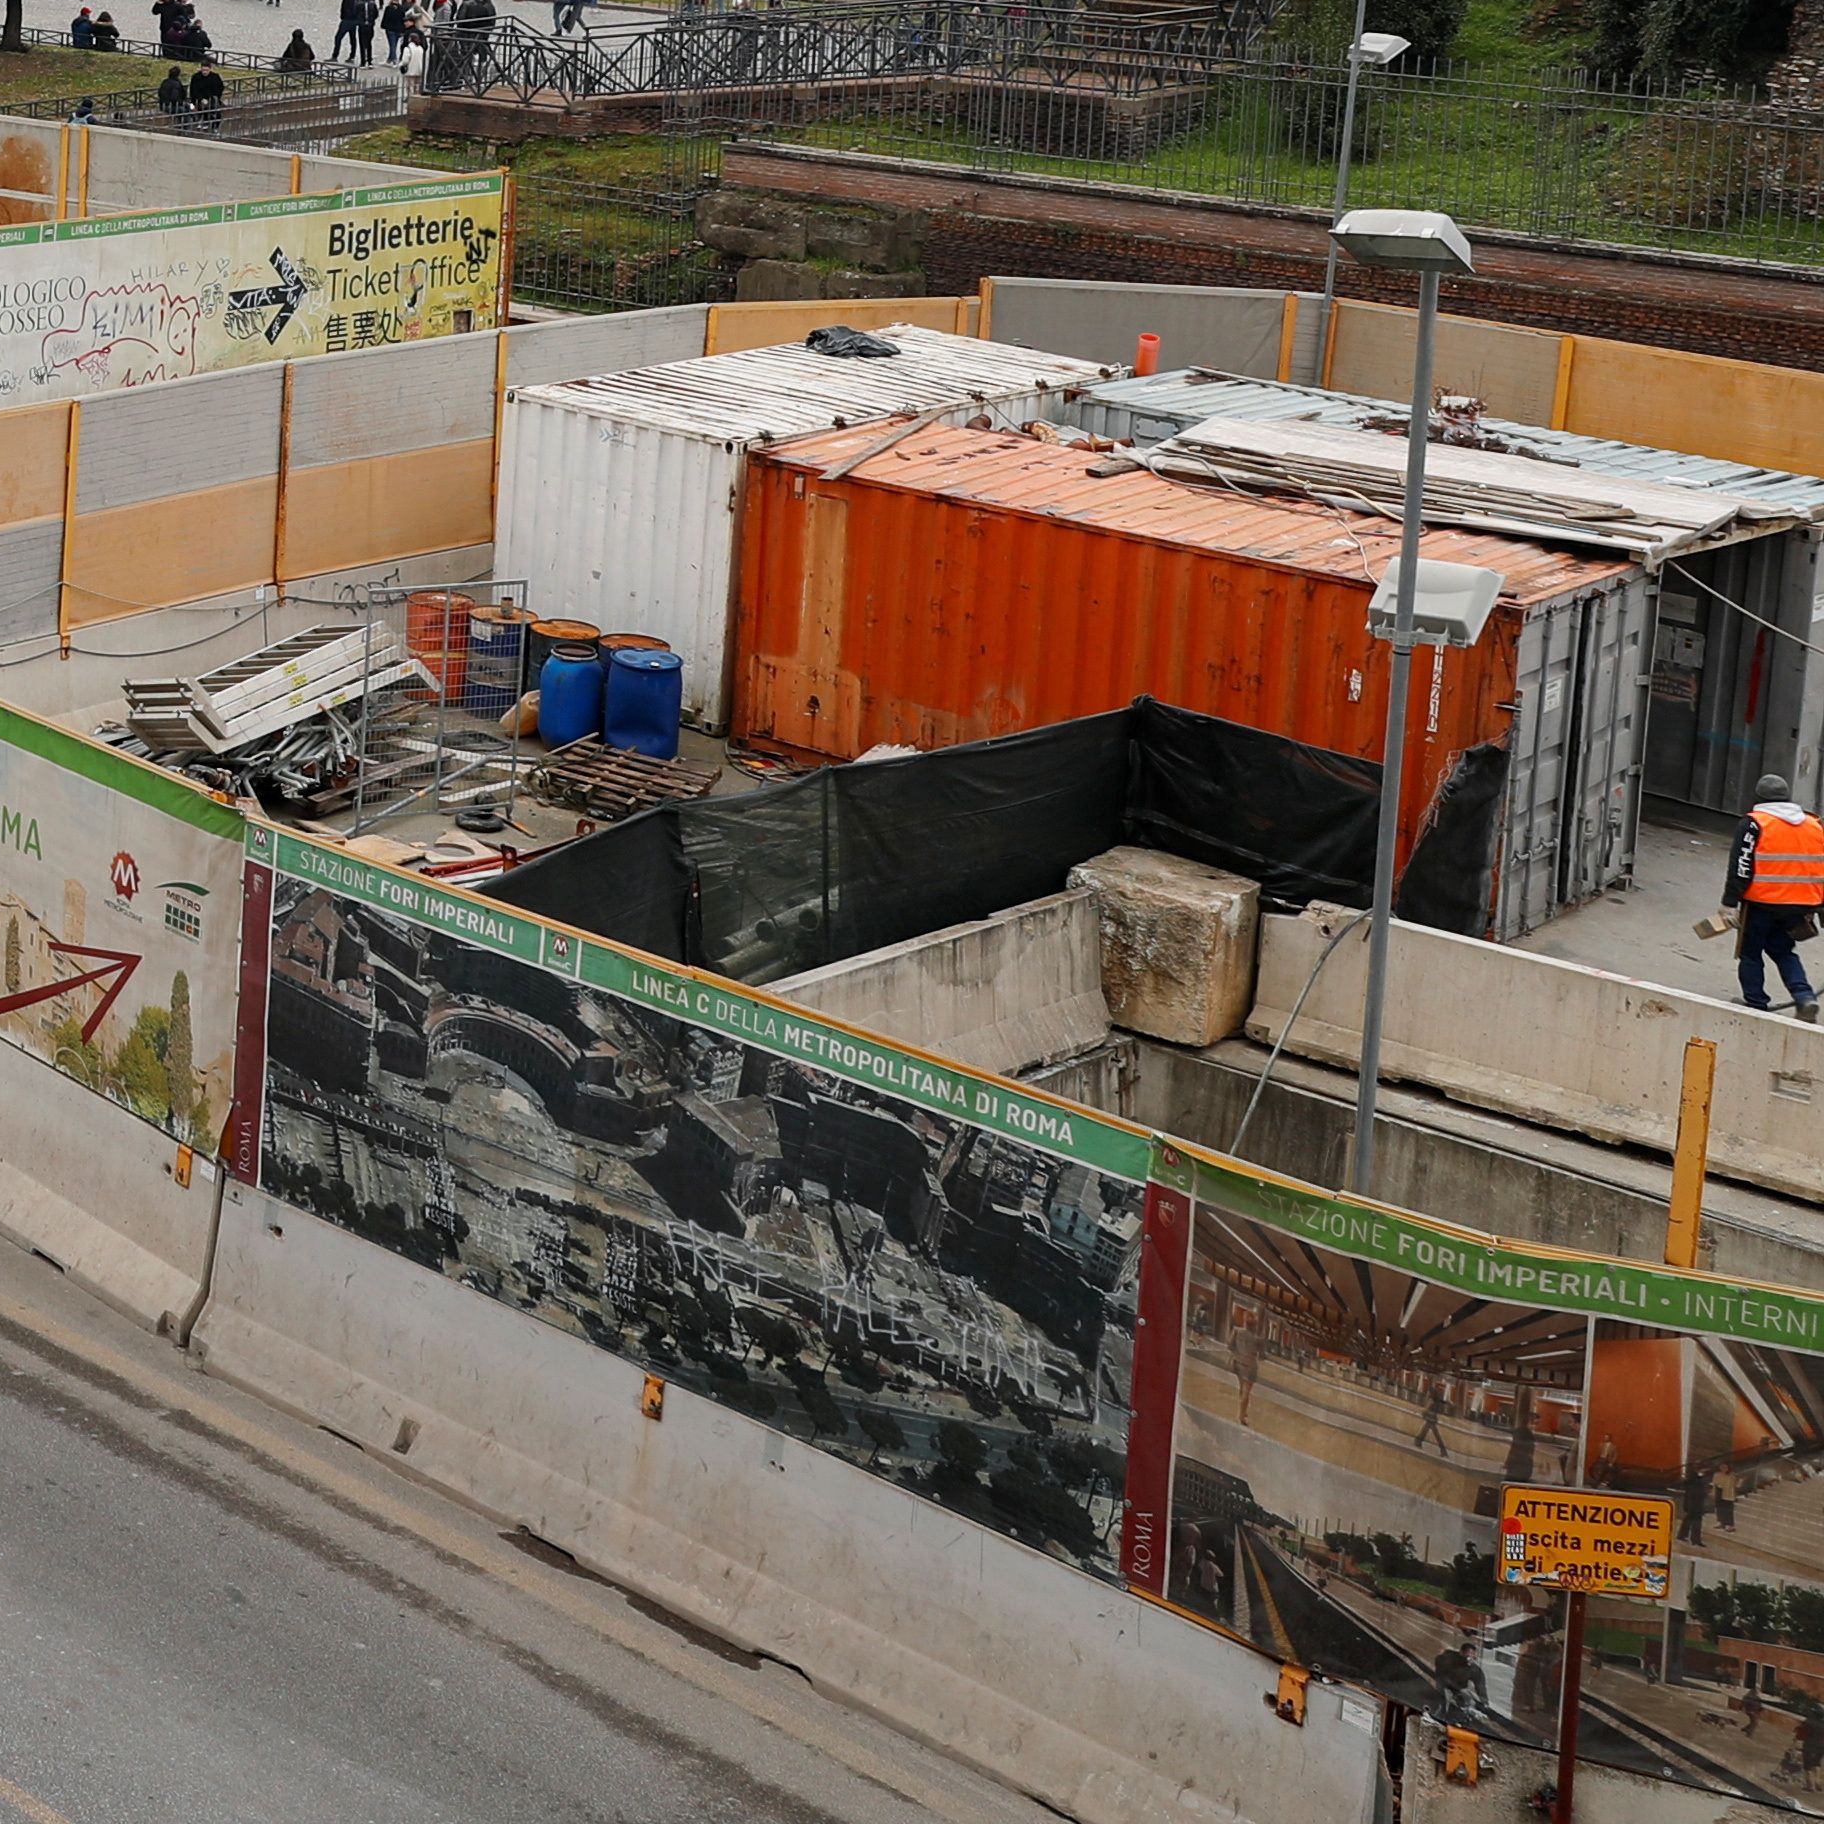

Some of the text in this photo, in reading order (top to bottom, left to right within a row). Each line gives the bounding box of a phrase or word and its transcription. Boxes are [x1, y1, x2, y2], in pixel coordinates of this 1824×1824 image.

[328, 210, 474, 261] Biglietterie
[327, 262, 400, 302] Ticket
[323, 307, 403, 354] 售票处
[114, 859, 137, 891] M
[299, 850, 515, 946] STAZIONE FORI IMPERIALI
[166, 890, 202, 912] METRO
[632, 969, 1074, 1147] LINEA C DELLA METROPOLITANA DI ROMA
[239, 1121, 251, 1173] ROMA
[1257, 1190, 1818, 1337] STAZIONE FORI IMPERIALI INTERNI
[1515, 1500, 1660, 1529] ATTENZIONE
[1133, 1513, 1153, 1578] ROMA
[1528, 1530, 1582, 1550] scita
[1594, 1538, 1656, 1556] mezzi
[1554, 1562, 1644, 1583] cantie
